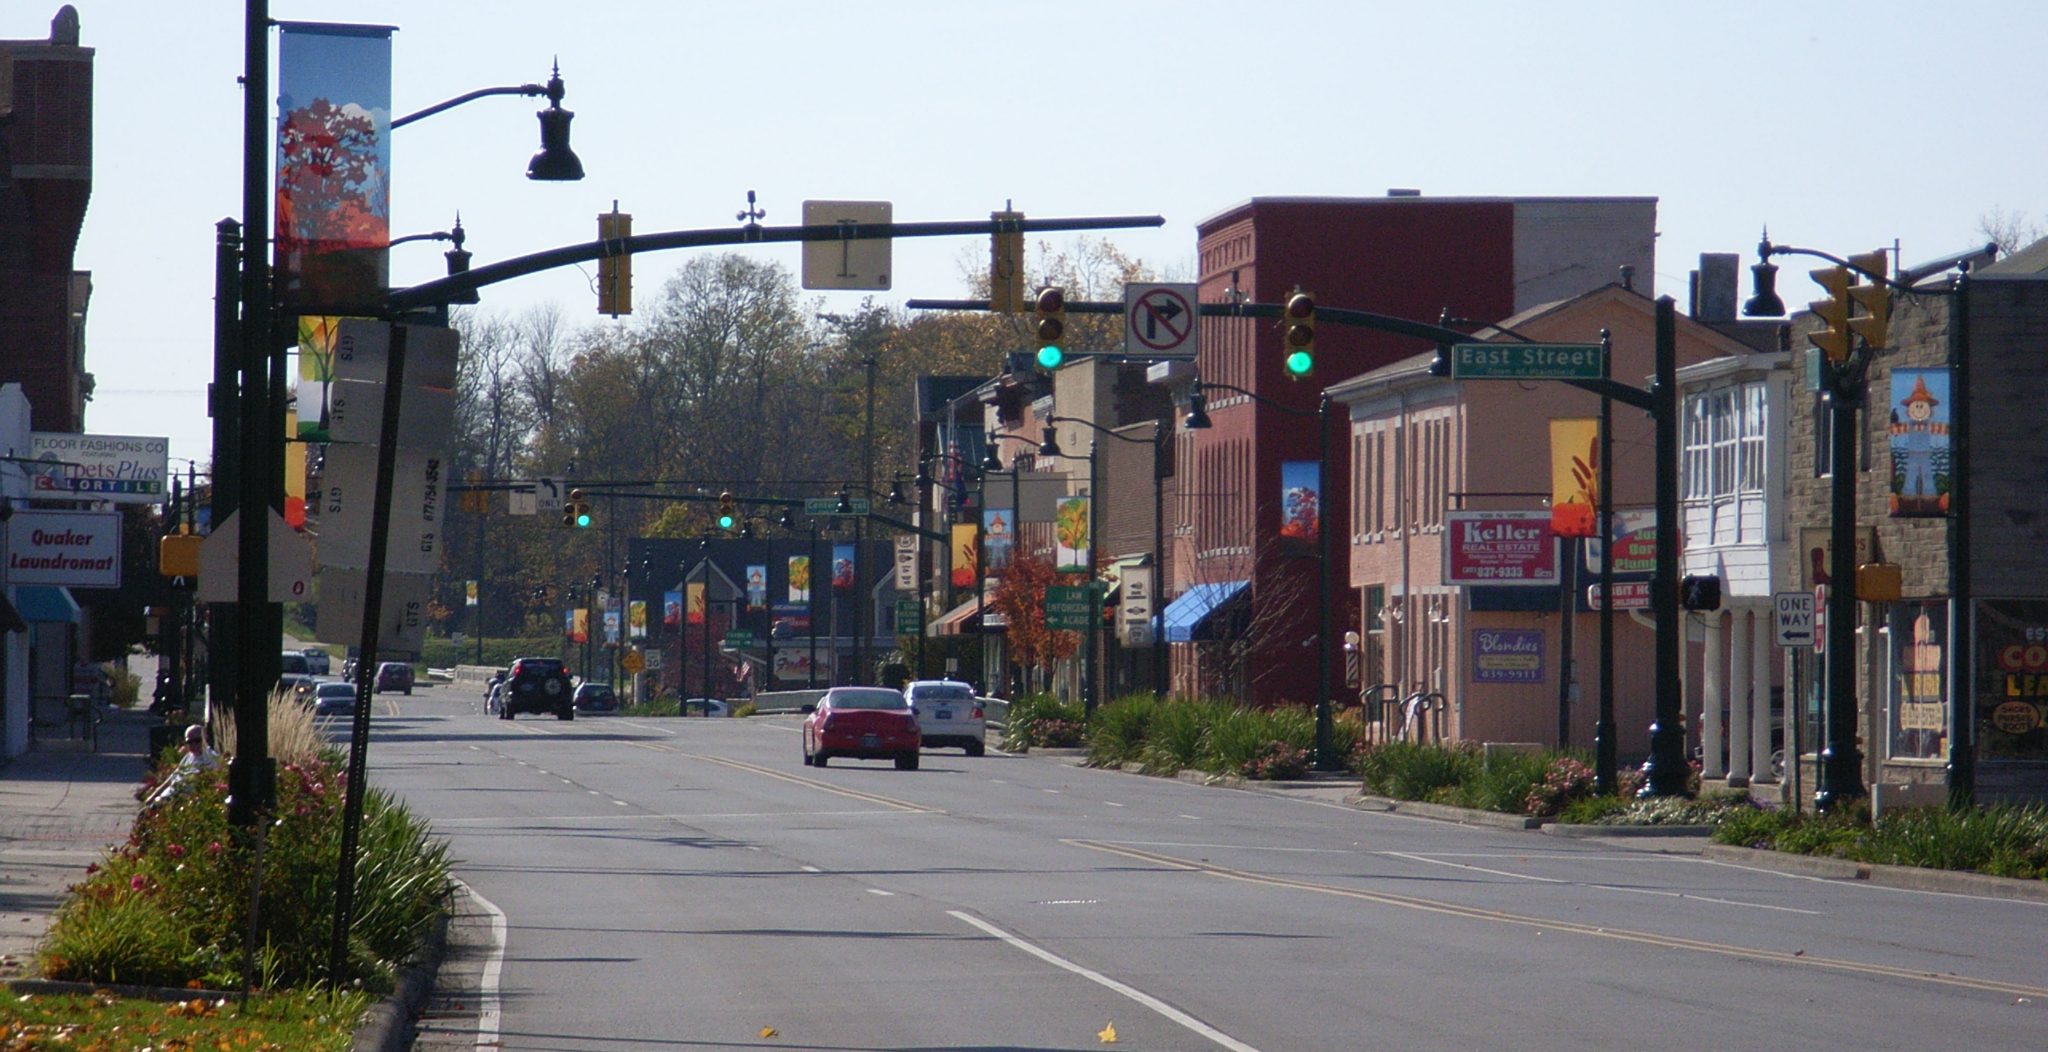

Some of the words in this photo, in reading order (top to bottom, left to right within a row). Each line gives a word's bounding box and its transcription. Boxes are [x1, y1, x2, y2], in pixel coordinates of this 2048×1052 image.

[1461, 348, 1510, 364] East
[1523, 348, 1594, 365] Street
[34, 439, 77, 449] FLOOR
[79, 441, 142, 452] FASHIONS
[145, 442, 164, 453] CO
[31, 528, 94, 546] Quaker
[1463, 520, 1540, 543] Keller
[10, 551, 113, 570] Laundromat
[1780, 598, 1810, 611] ONE
[1780, 613, 1811, 626] WAY
[1479, 633, 1538, 652] Blondies
